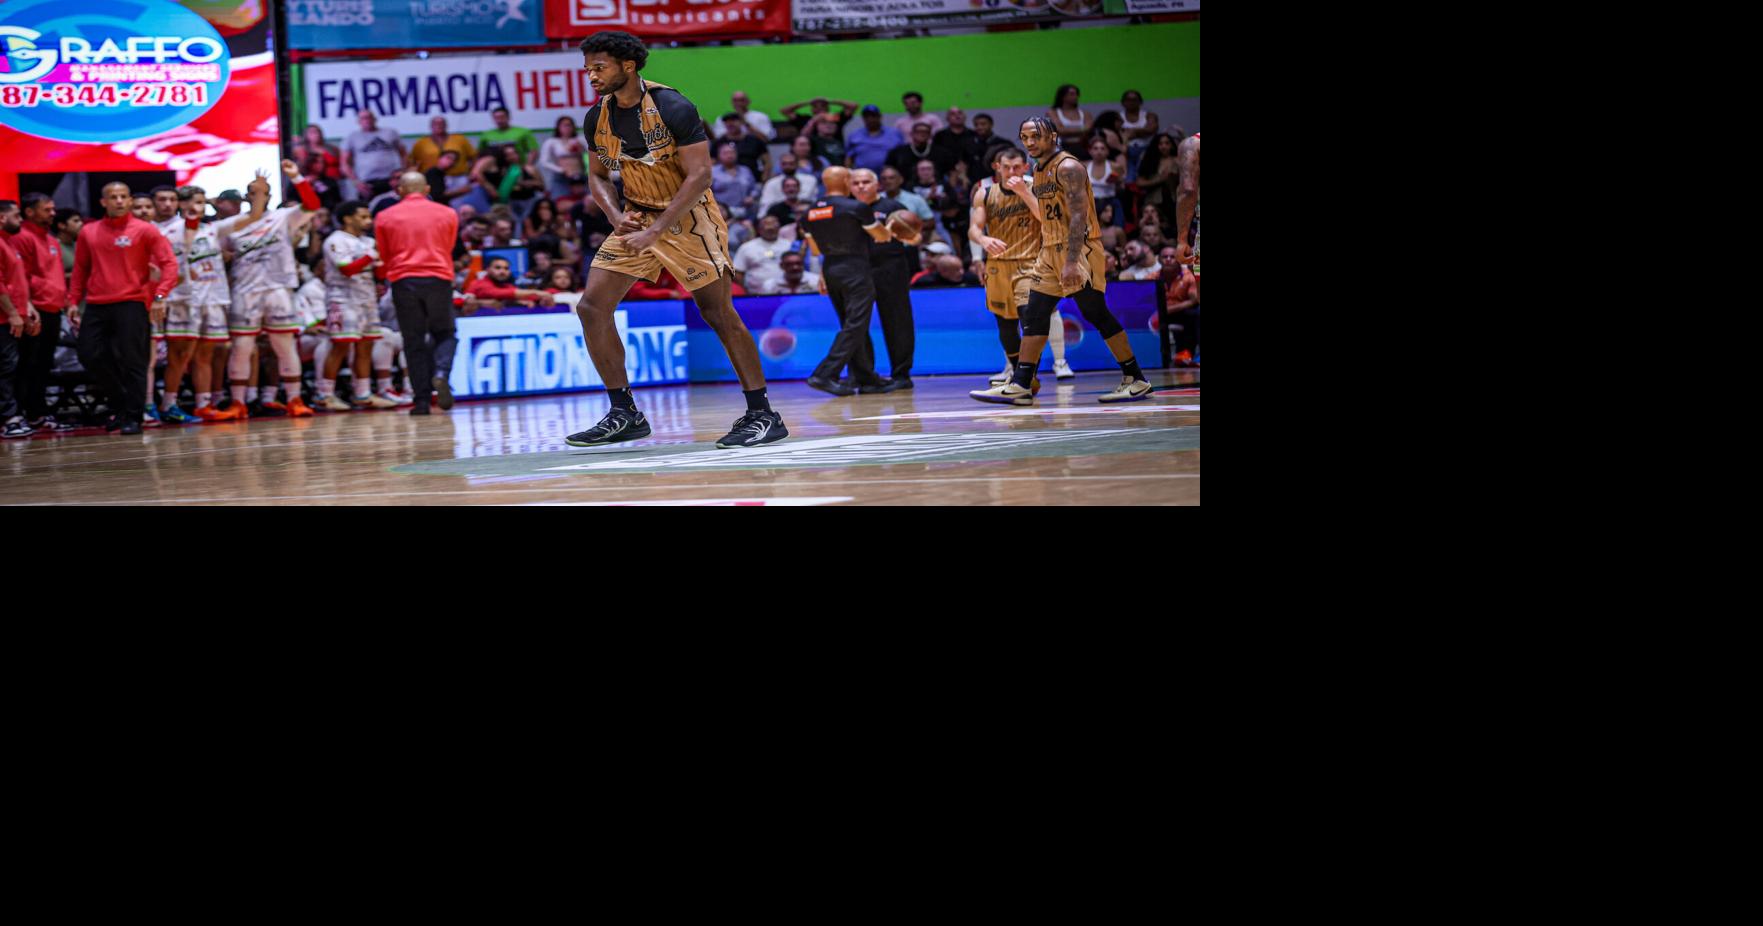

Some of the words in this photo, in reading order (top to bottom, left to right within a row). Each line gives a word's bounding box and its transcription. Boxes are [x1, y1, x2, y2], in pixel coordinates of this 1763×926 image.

[631, 8, 766, 24] lubricants
[316, 72, 507, 119] FARMACIA
[1045, 203, 1063, 220] 24
[1018, 217, 1031, 227] 22
